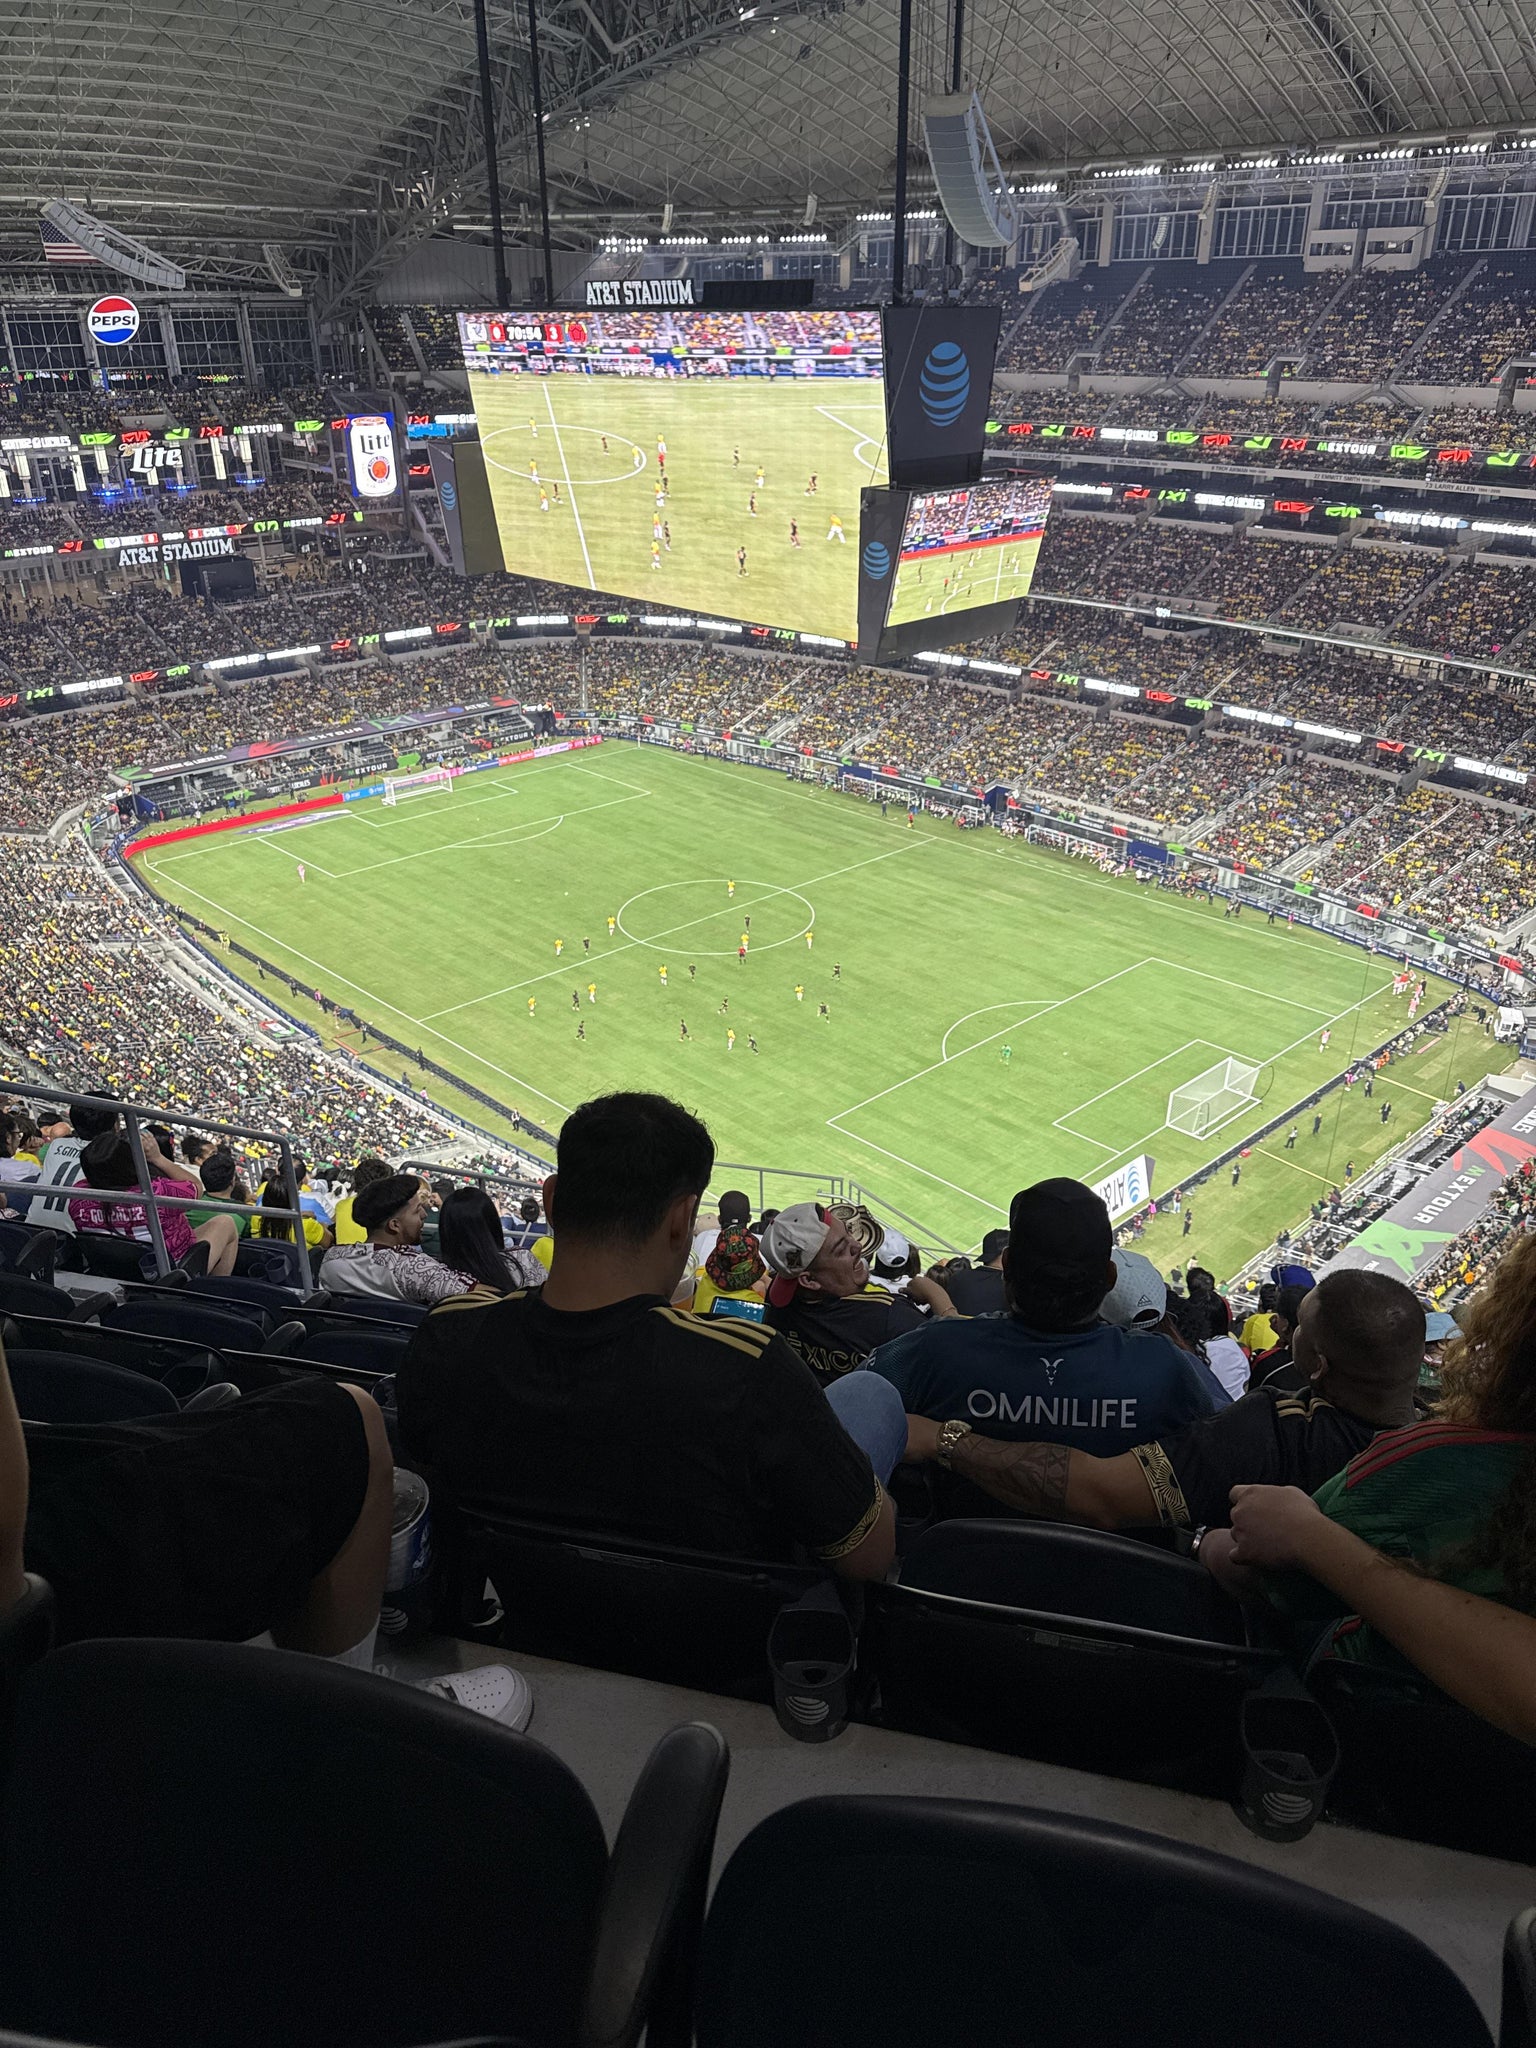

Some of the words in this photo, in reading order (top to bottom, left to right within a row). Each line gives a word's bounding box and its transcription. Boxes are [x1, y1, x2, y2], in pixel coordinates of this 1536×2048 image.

[586, 281, 620, 305] AT&T
[624, 280, 694, 305] STADIUM
[91, 314, 137, 327] PEPSI
[507, 326, 542, 340] 70:54
[550, 326, 558, 339] 3
[1317, 441, 1377, 455] MEXTOUR
[130, 447, 182, 474] Lite
[1434, 483, 1455, 491] LARRY
[1455, 485, 1476, 493] ALLEN
[1384, 510, 1420, 526] VISIT
[1421, 512, 1441, 527] US
[1440, 514, 1459, 530] AT
[118, 545, 159, 567] AT&T
[163, 537, 235, 563] STADIUM
[1100, 1173, 1126, 1214] AT&
[1413, 1164, 1487, 1225] MEXTOUR
[967, 1389, 1137, 1429] OMNILIFE
